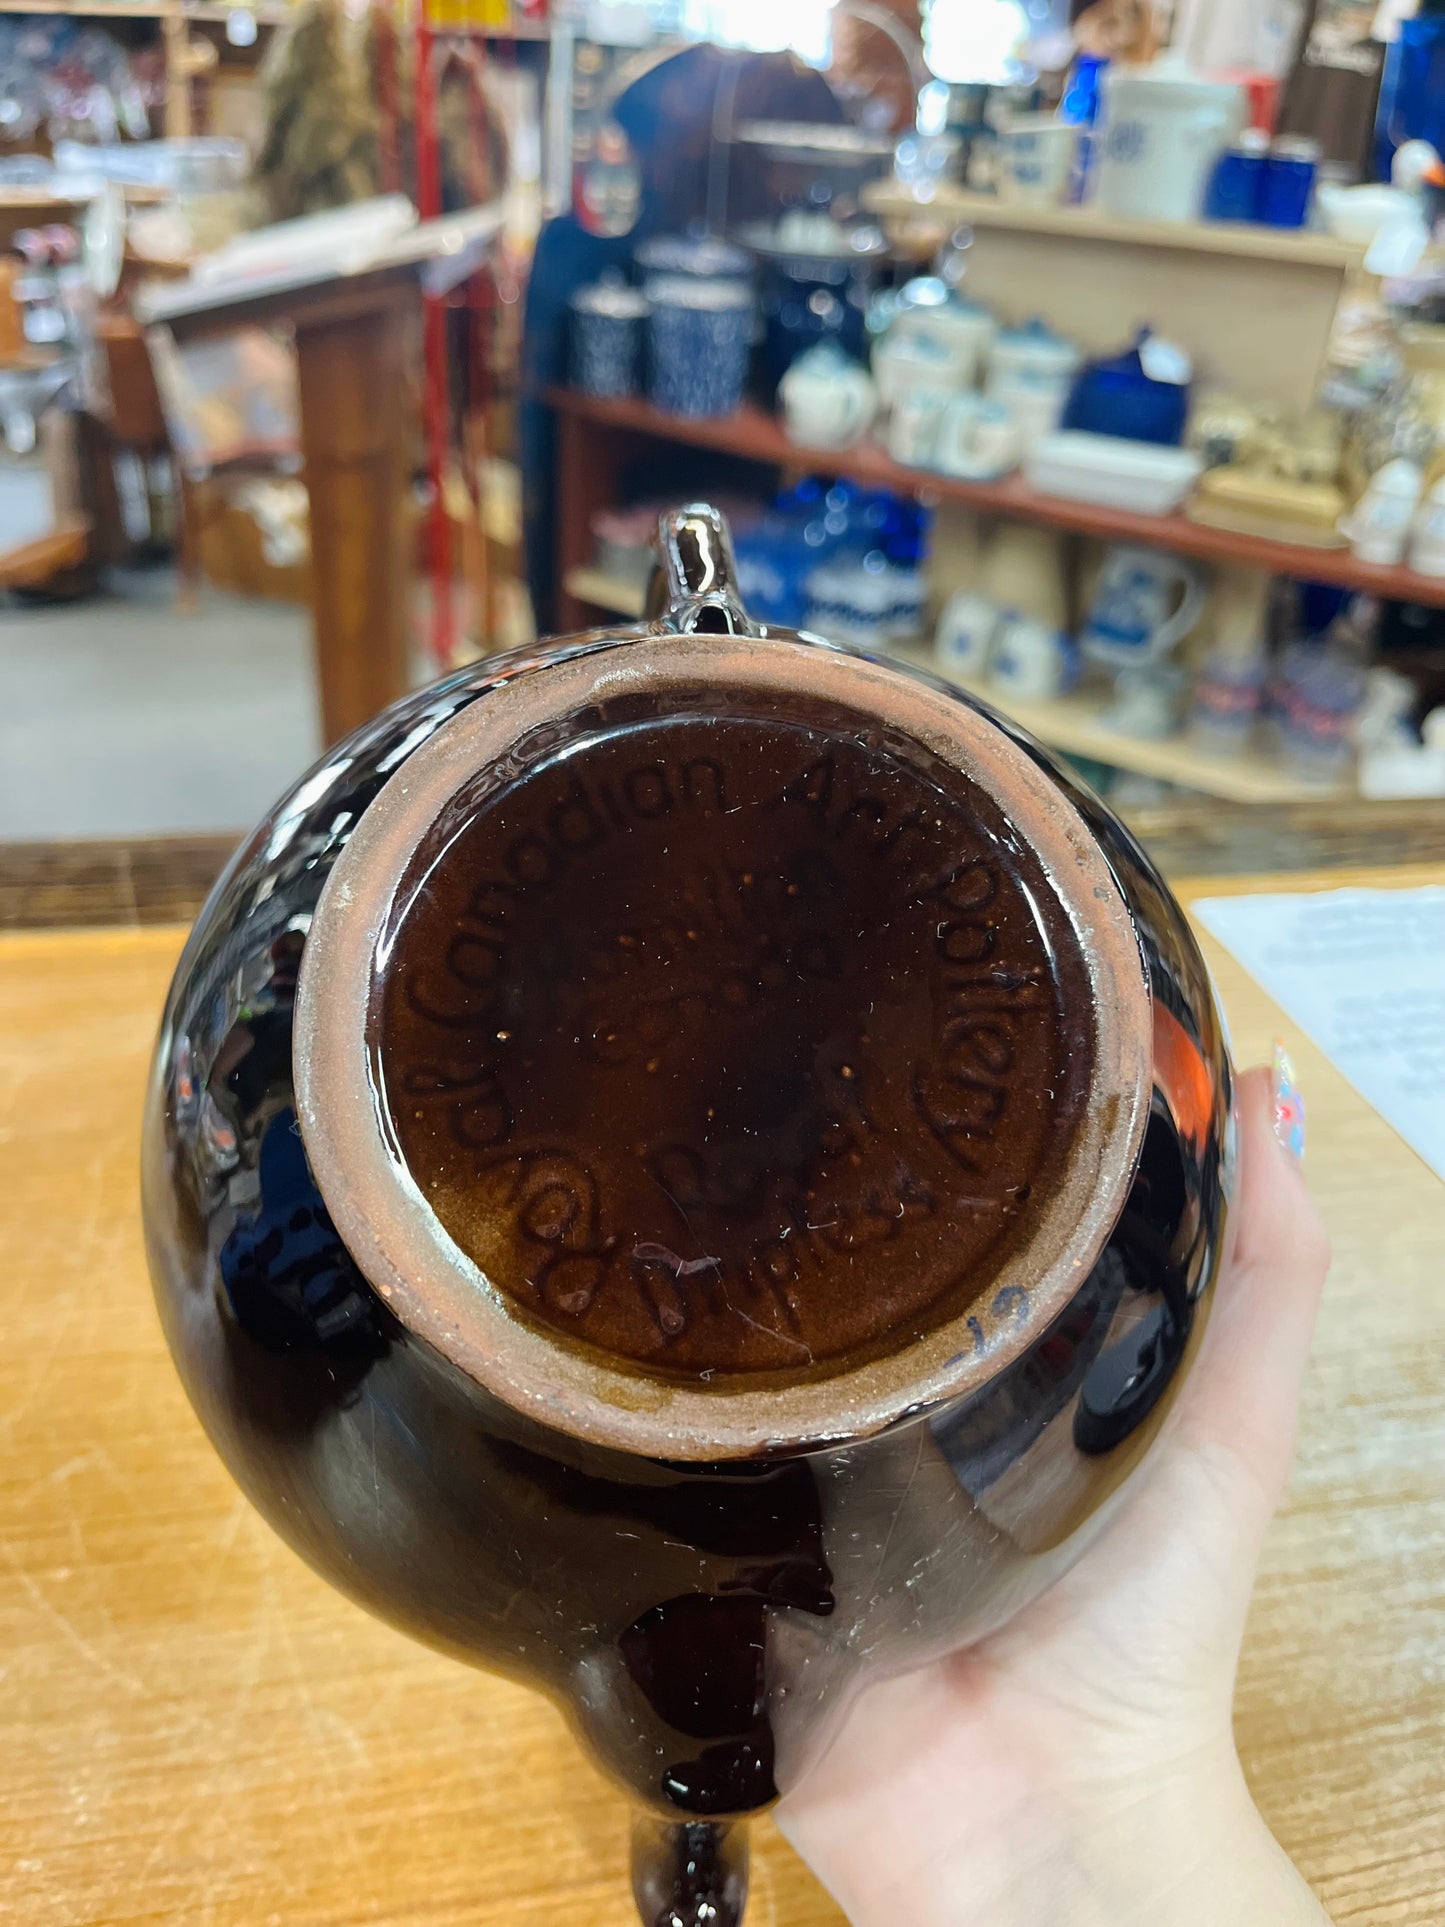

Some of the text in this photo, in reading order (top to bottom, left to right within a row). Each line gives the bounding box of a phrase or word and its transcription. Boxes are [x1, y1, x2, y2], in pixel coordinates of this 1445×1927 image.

[405, 757, 729, 1029] Canadian
[765, 752, 937, 864] Art
[901, 857, 1048, 1176] Pottery
